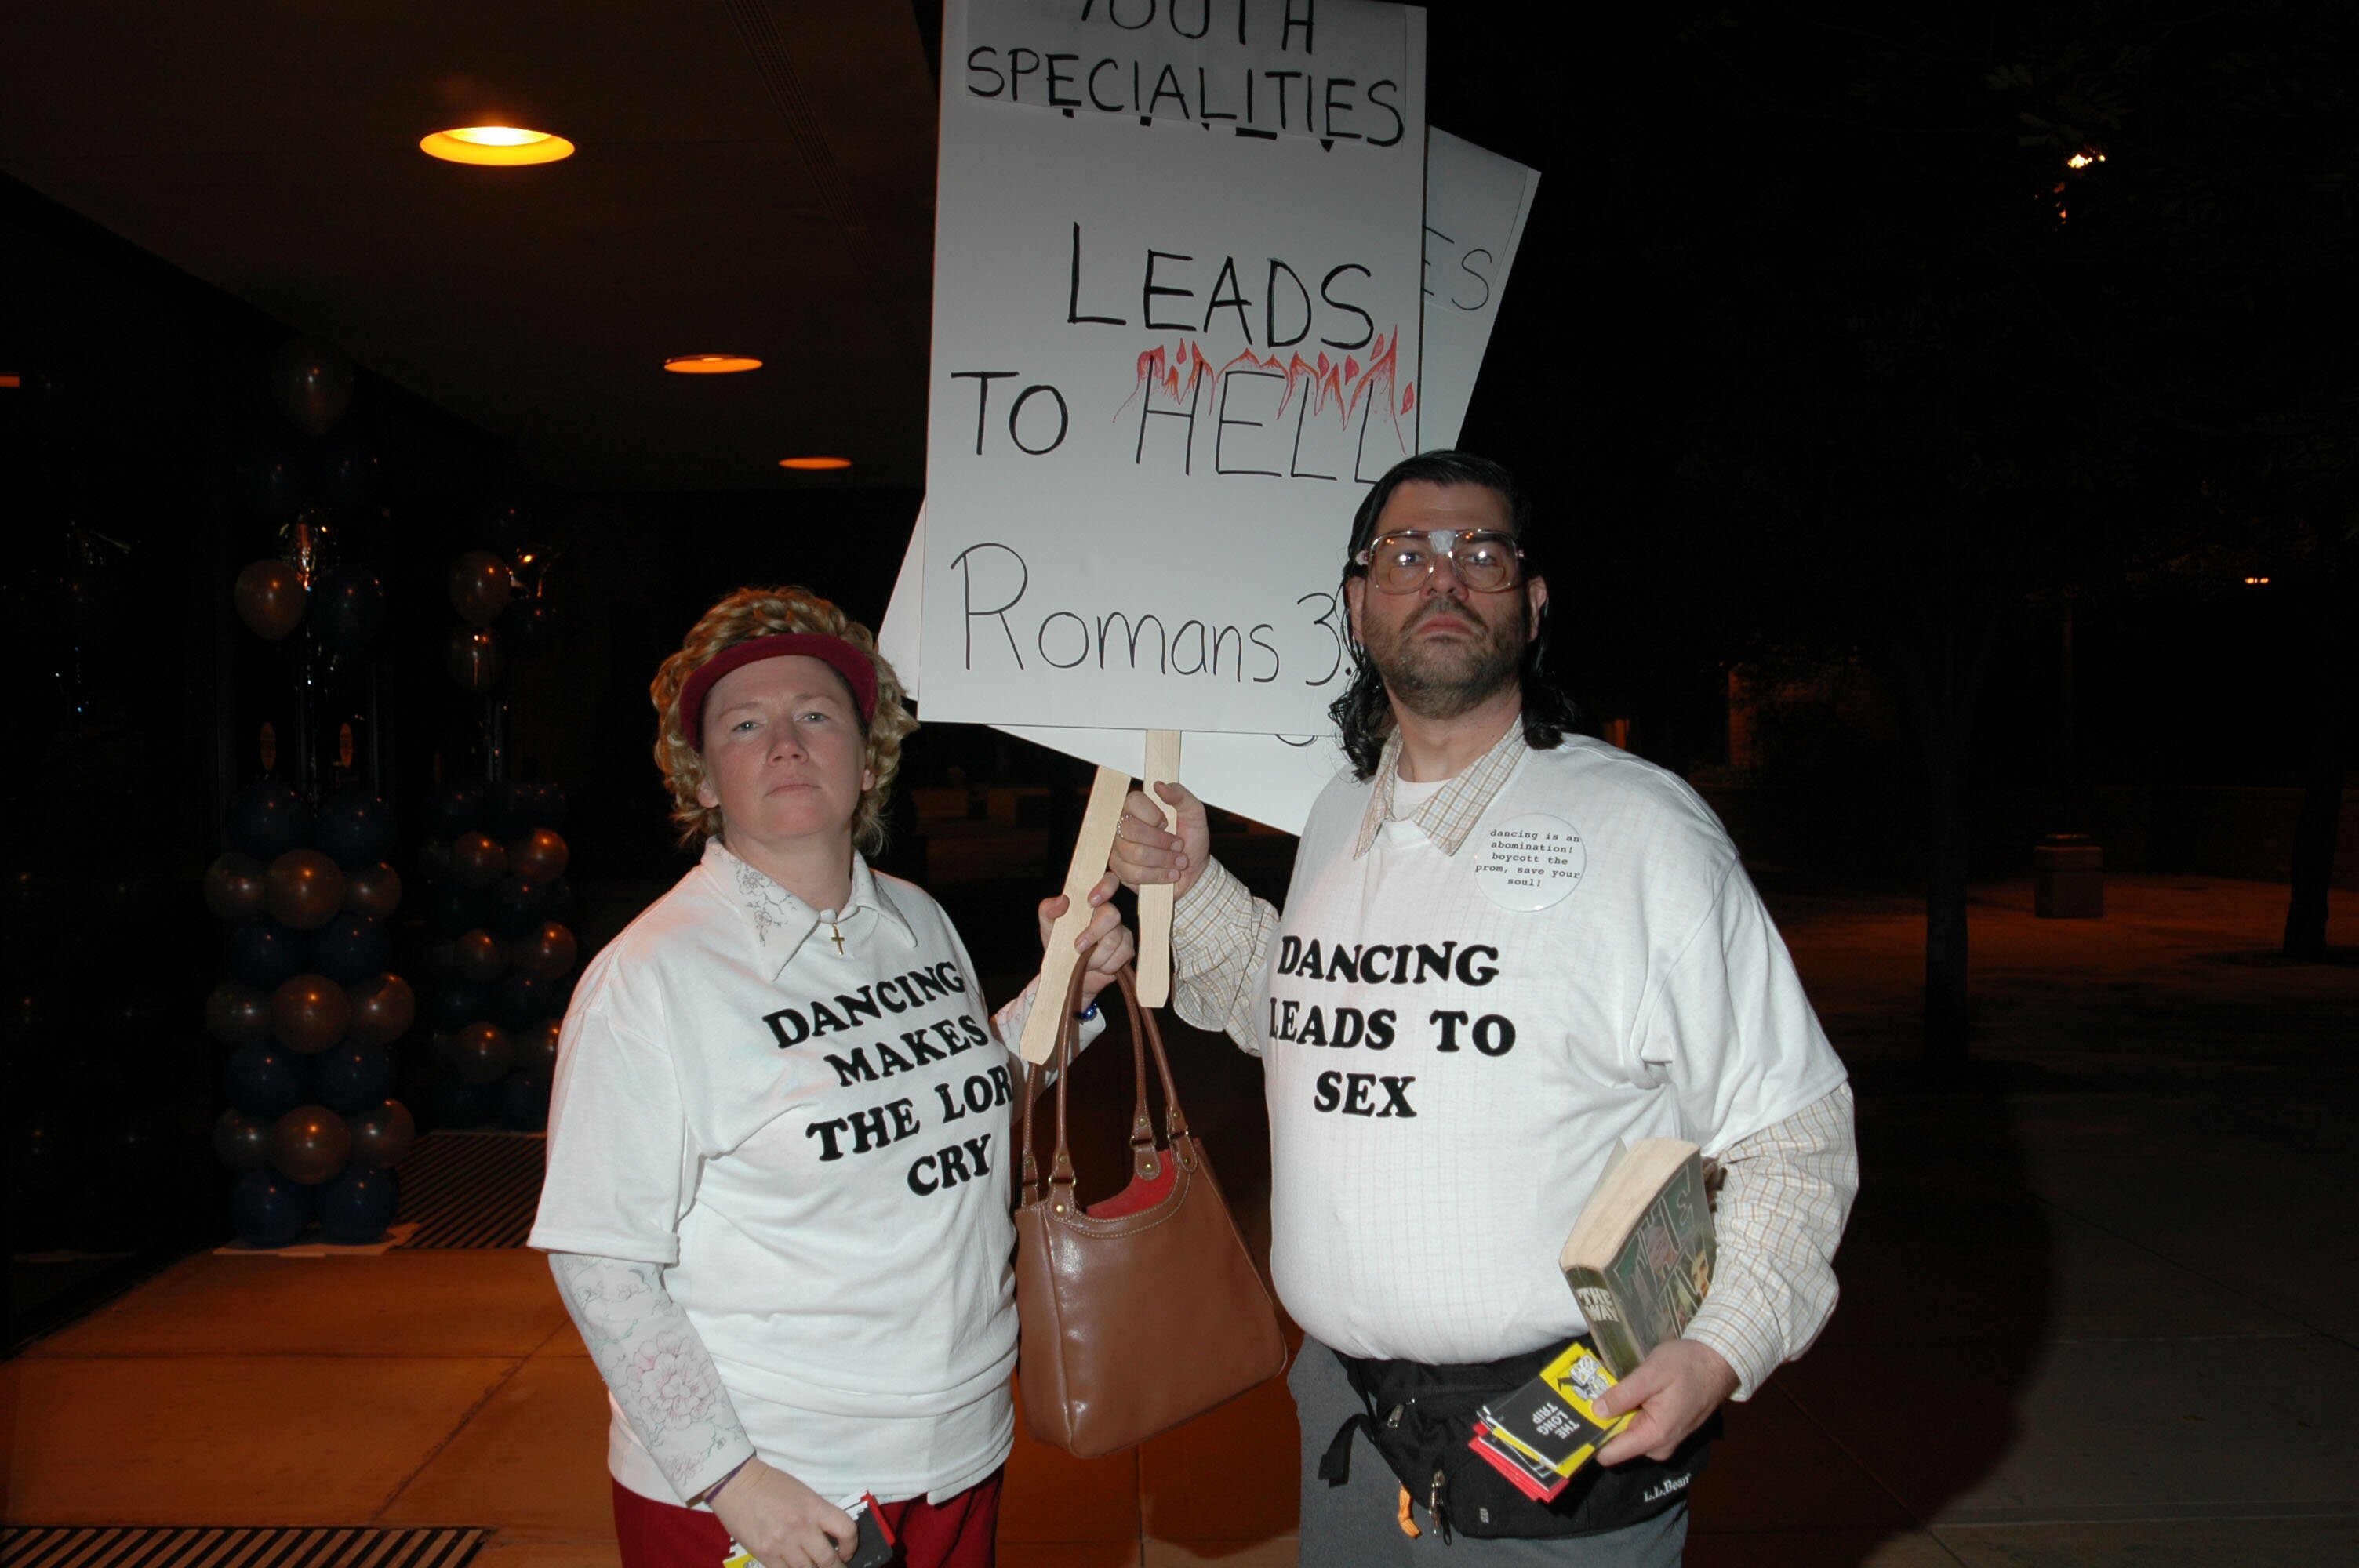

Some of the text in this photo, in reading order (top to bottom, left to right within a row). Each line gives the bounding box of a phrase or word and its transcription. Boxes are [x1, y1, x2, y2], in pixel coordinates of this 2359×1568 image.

[967, 46, 1404, 147] SPECIALITIES
[1067, 222, 1374, 350] LEADS
[951, 354, 1379, 485] TO HELL
[951, 542, 1280, 684] Romans
[1490, 829, 1539, 840] dancing
[1546, 832, 1558, 840] is
[1491, 841, 1573, 854] abomination!
[1492, 852, 1568, 866] boycott the
[1475, 864, 1580, 879] prom, save your
[1507, 877, 1542, 887] soul!
[1277, 935, 1500, 987] DANCING
[762, 961, 966, 1049] DANCING
[1269, 996, 1517, 1057] LEADS TO
[823, 1014, 989, 1087] MAKES
[806, 1063, 1013, 1161] THE LOR
[1314, 1070, 1418, 1117] SEX
[907, 1134, 992, 1196] CRY
[1532, 1402, 1558, 1425] TRIP
[1536, 1410, 1568, 1435] LONG
[1554, 1419, 1580, 1439] THE
